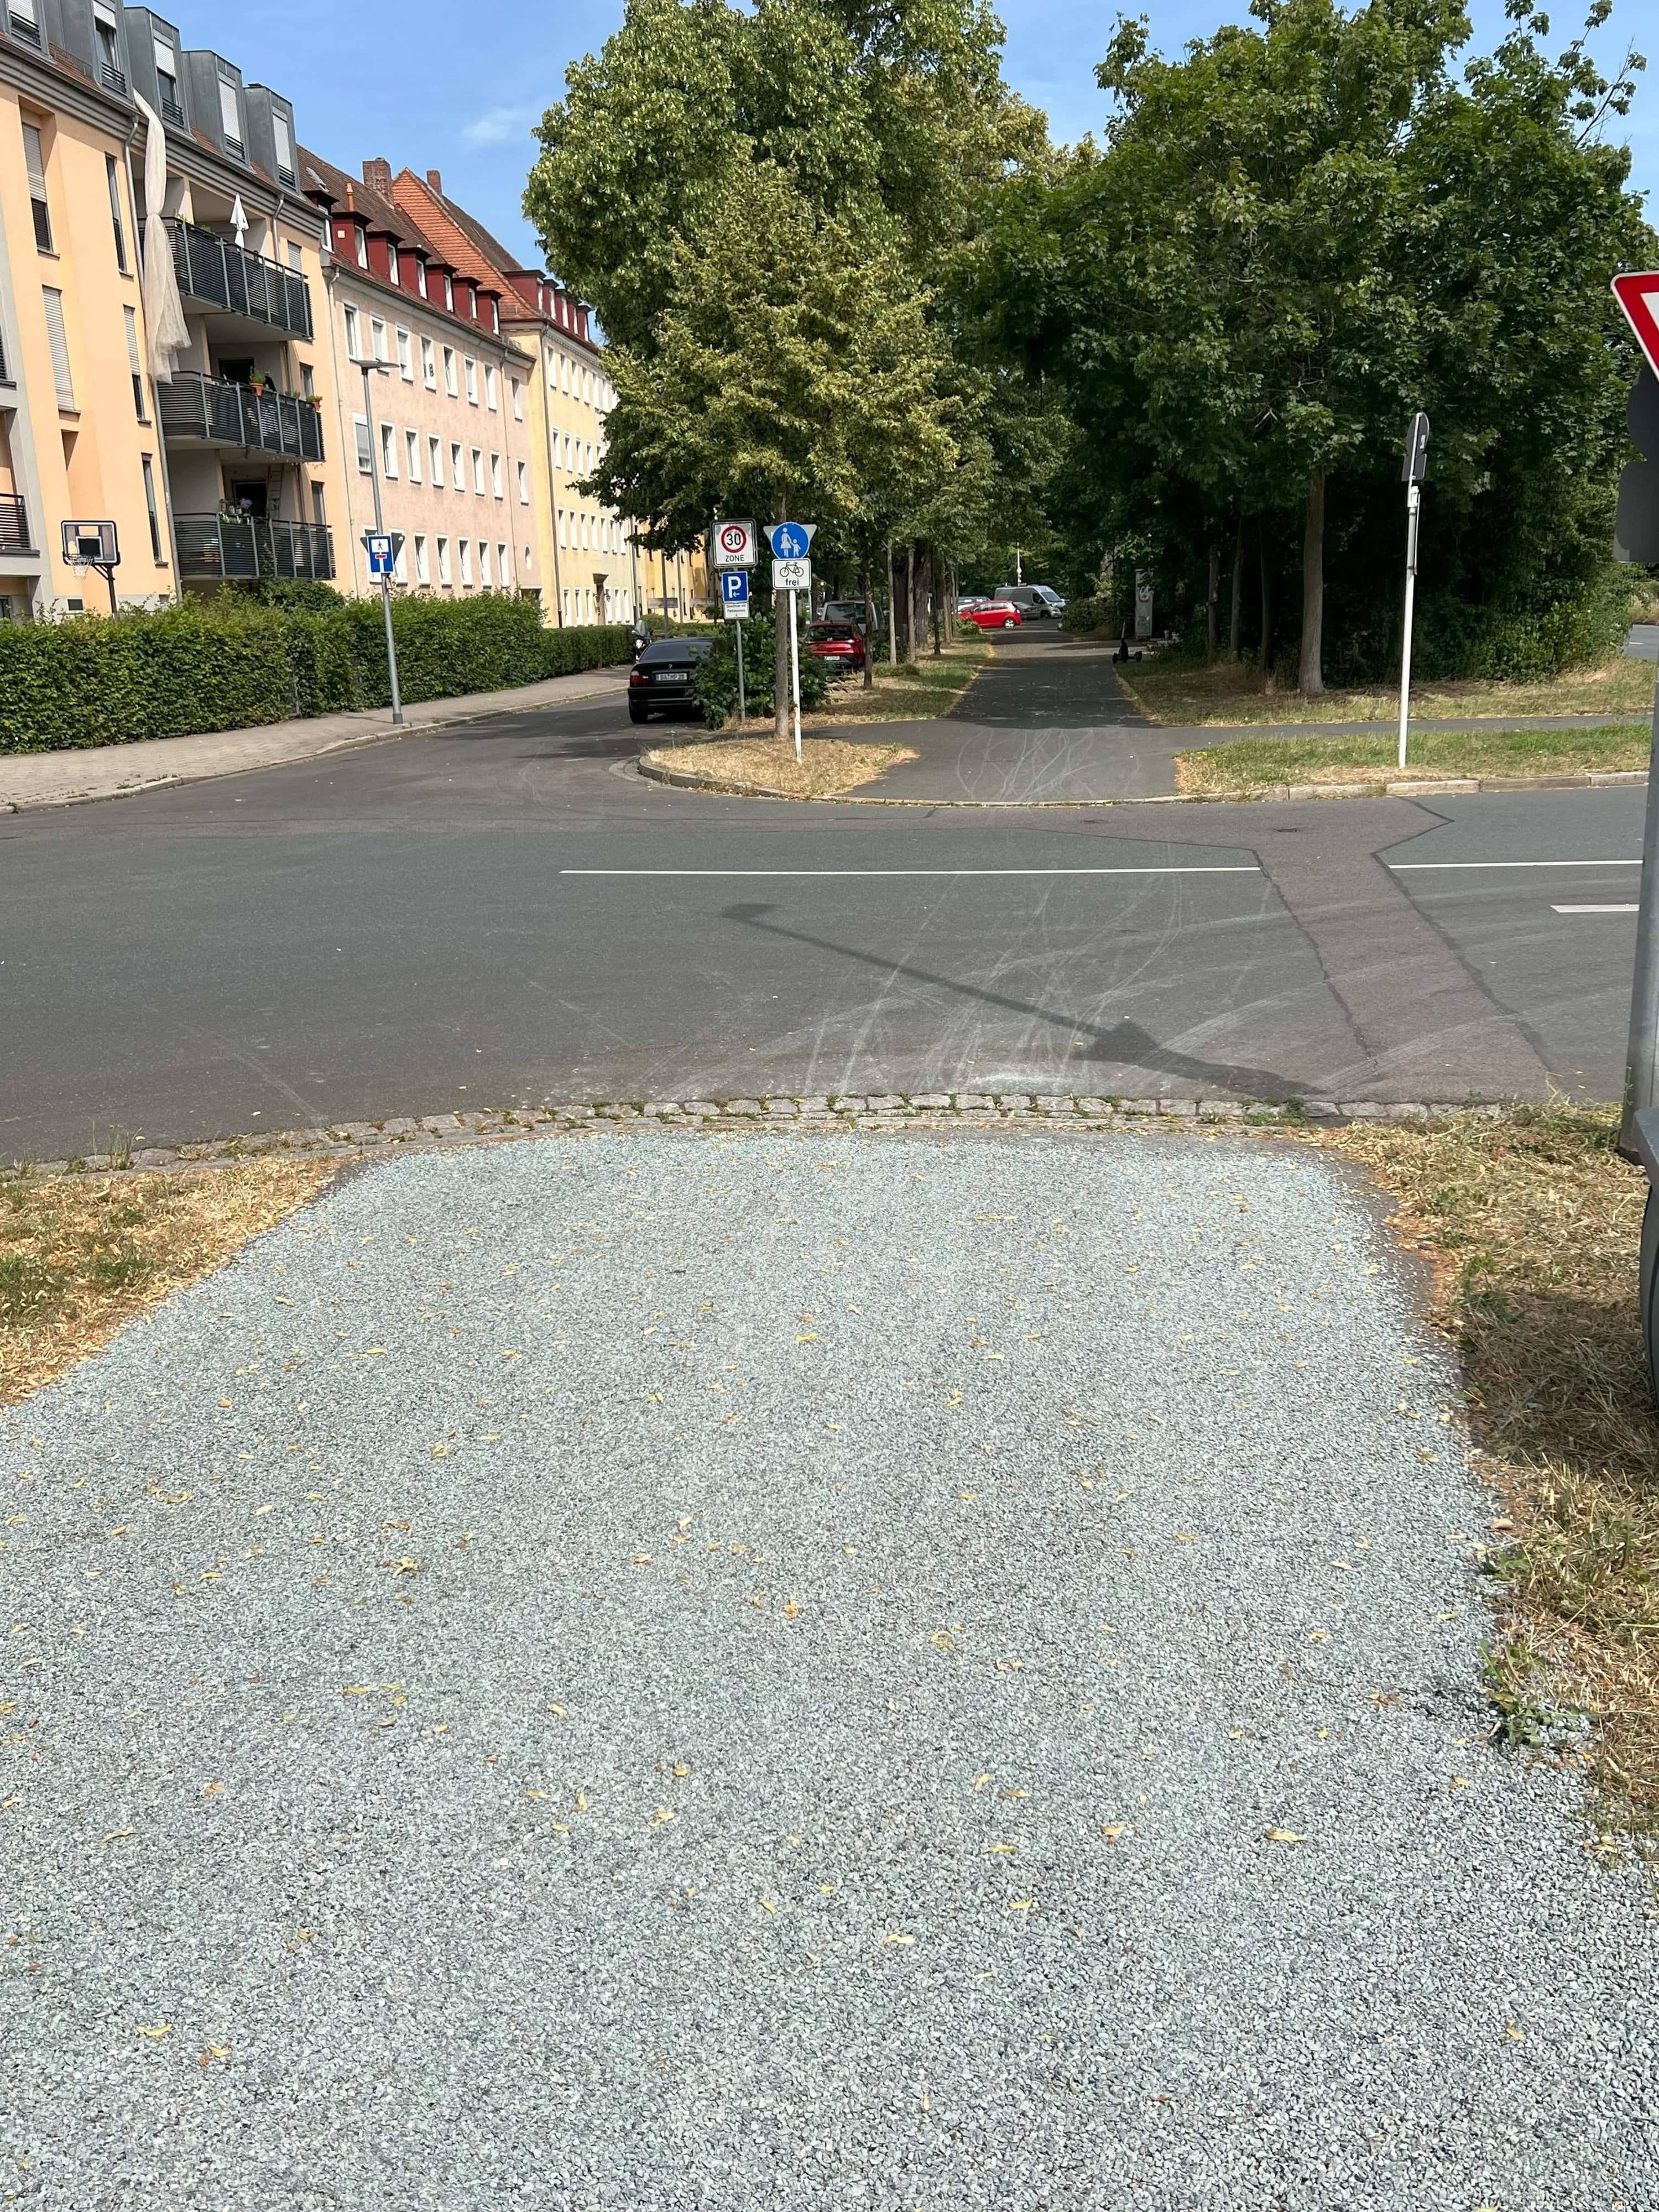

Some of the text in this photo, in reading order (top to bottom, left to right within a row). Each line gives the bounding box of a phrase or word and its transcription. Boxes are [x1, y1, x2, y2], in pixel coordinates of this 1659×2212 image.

[727, 533, 741, 546] 30
[725, 554, 745, 562] ZONE
[728, 576, 742, 598] P
